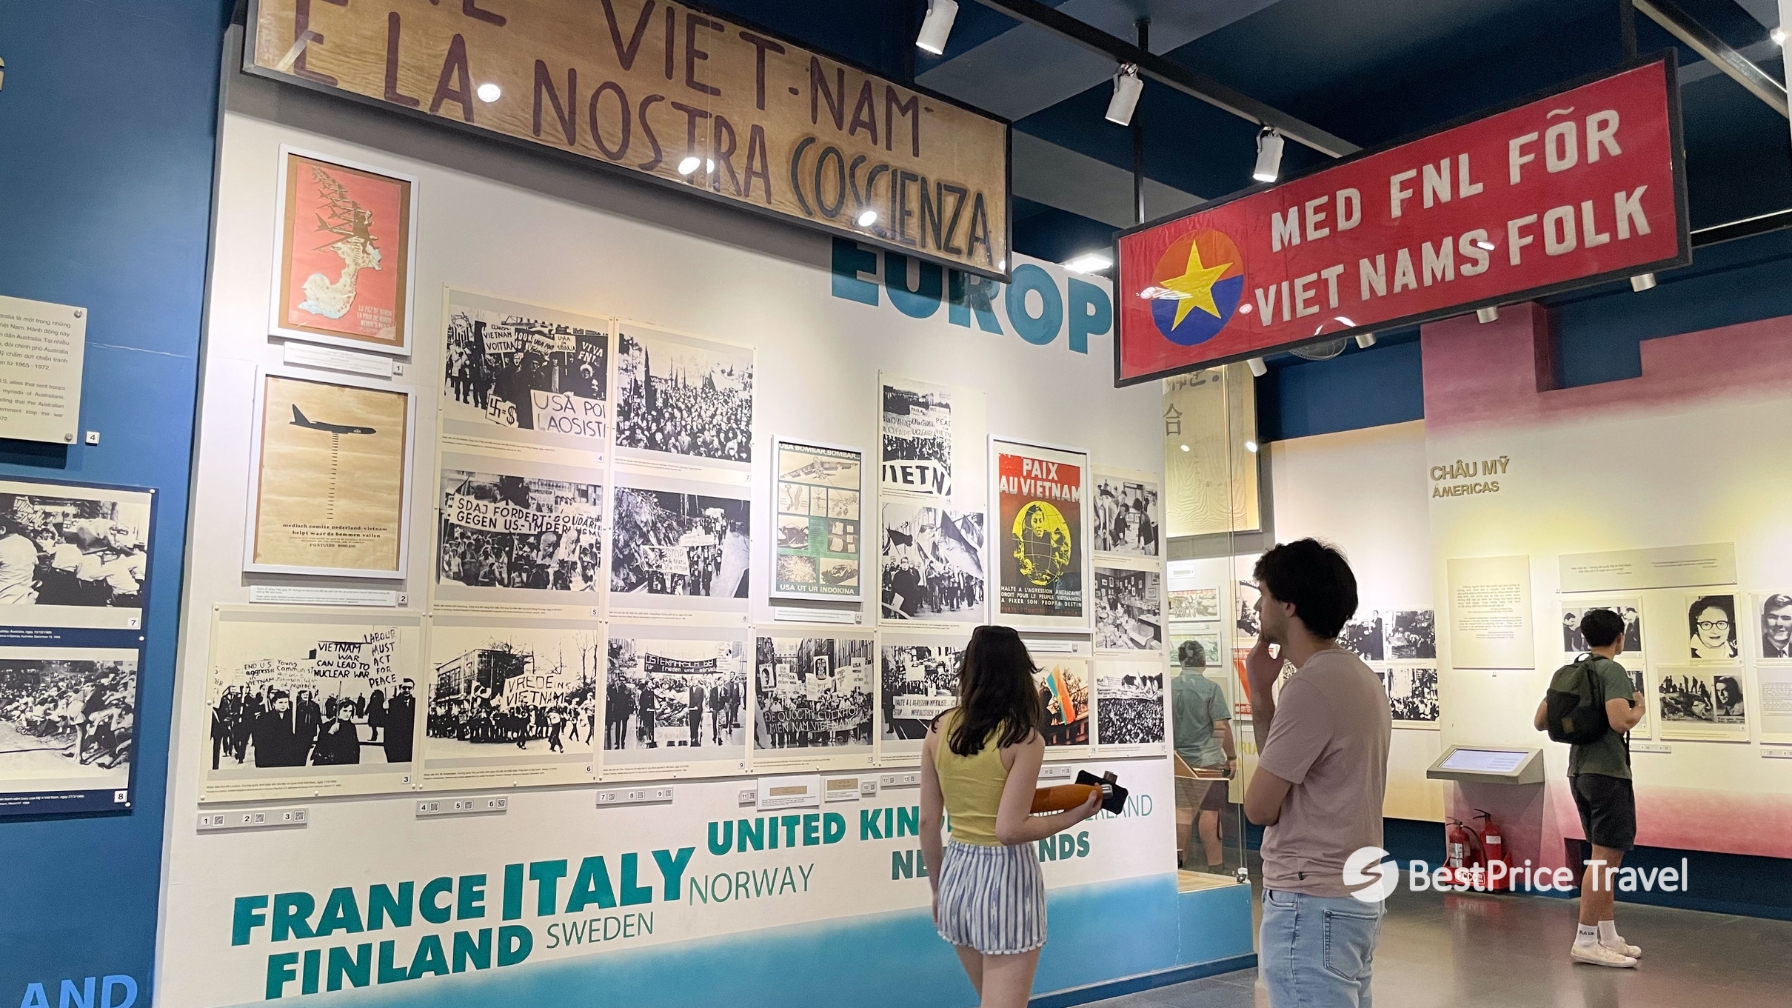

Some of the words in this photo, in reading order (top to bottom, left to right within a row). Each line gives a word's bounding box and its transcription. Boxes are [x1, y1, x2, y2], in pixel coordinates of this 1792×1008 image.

[294, 0, 348, 86] E
[384, 12, 474, 123] LA
[533, 59, 771, 204] NOSTRA
[791, 137, 993, 267] COSCIENZA
[1271, 187, 1361, 252] MED
[1391, 153, 1483, 218] FNL
[1254, 264, 1344, 326] VIET
[1359, 228, 1490, 300] NAMS
[1507, 185, 1651, 265] FOLK
[831, 237, 1112, 354] EUROP
[534, 394, 575, 414] USA
[1022, 459, 1058, 480] PAIX
[1430, 459, 1477, 481] CHÂU
[1482, 456, 1510, 476] MỸ
[1000, 475, 1018, 494] AU
[1020, 476, 1080, 503] VIETNAM
[457, 498, 488, 515] SDAJ
[457, 511, 497, 529] GEGEN
[780, 583, 795, 591] USA
[820, 586, 855, 595] INDOKINA
[131, 619, 136, 627] 7
[318, 643, 361, 653] VIETNAM
[372, 642, 395, 657] MUST
[337, 660, 356, 669] LEAD
[359, 662, 370, 671] TO
[338, 654, 360, 662] WAR
[374, 655, 391, 667] ACT
[314, 670, 350, 678] NUCLEAR
[377, 666, 392, 675] FOR
[369, 674, 397, 688] PEACE
[509, 676, 554, 693] VREDE
[507, 690, 564, 706] VIETNAM
[707, 813, 847, 856] UNITED
[689, 863, 814, 905] NORWAY
[231, 874, 488, 946] FRANCE
[501, 846, 696, 921] ITALY
[265, 925, 533, 1000] FINLAND
[546, 912, 655, 948] SWEDEN
[20, 974, 138, 1008] AND
